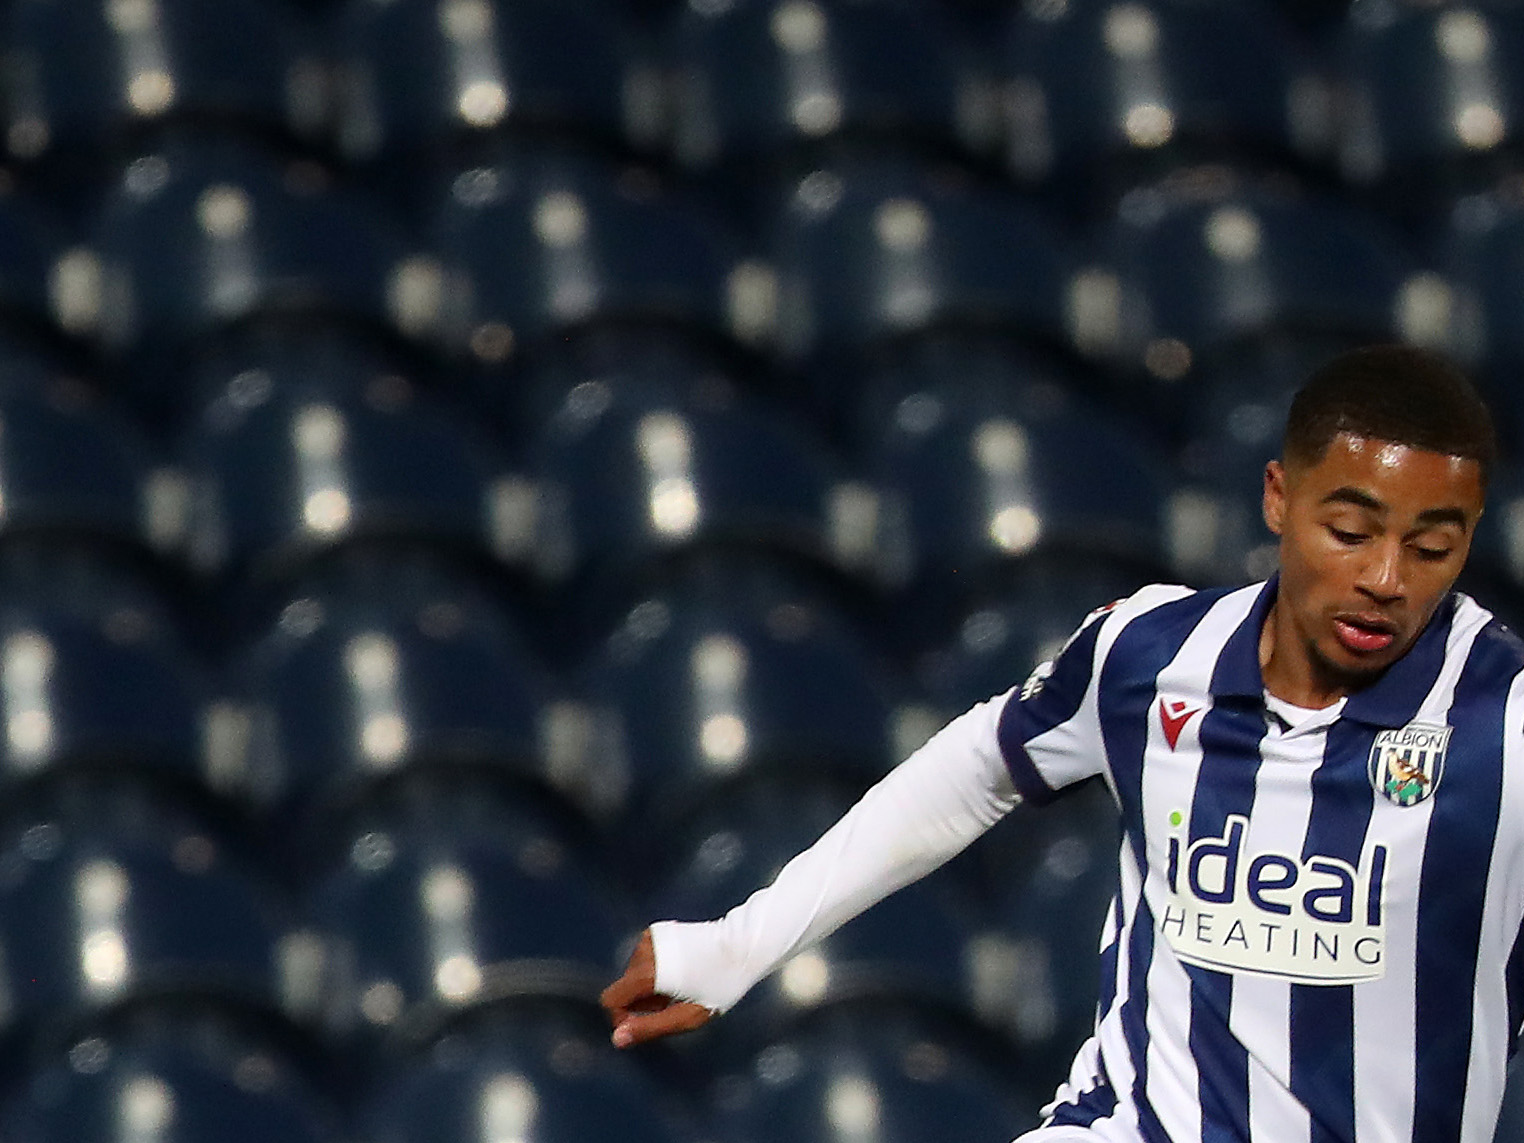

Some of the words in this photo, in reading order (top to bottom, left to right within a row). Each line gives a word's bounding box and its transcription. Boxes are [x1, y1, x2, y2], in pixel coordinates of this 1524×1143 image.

[1380, 730, 1443, 749] ALBION
[1167, 811, 1386, 926] ideal
[1161, 905, 1381, 964] HEATING
